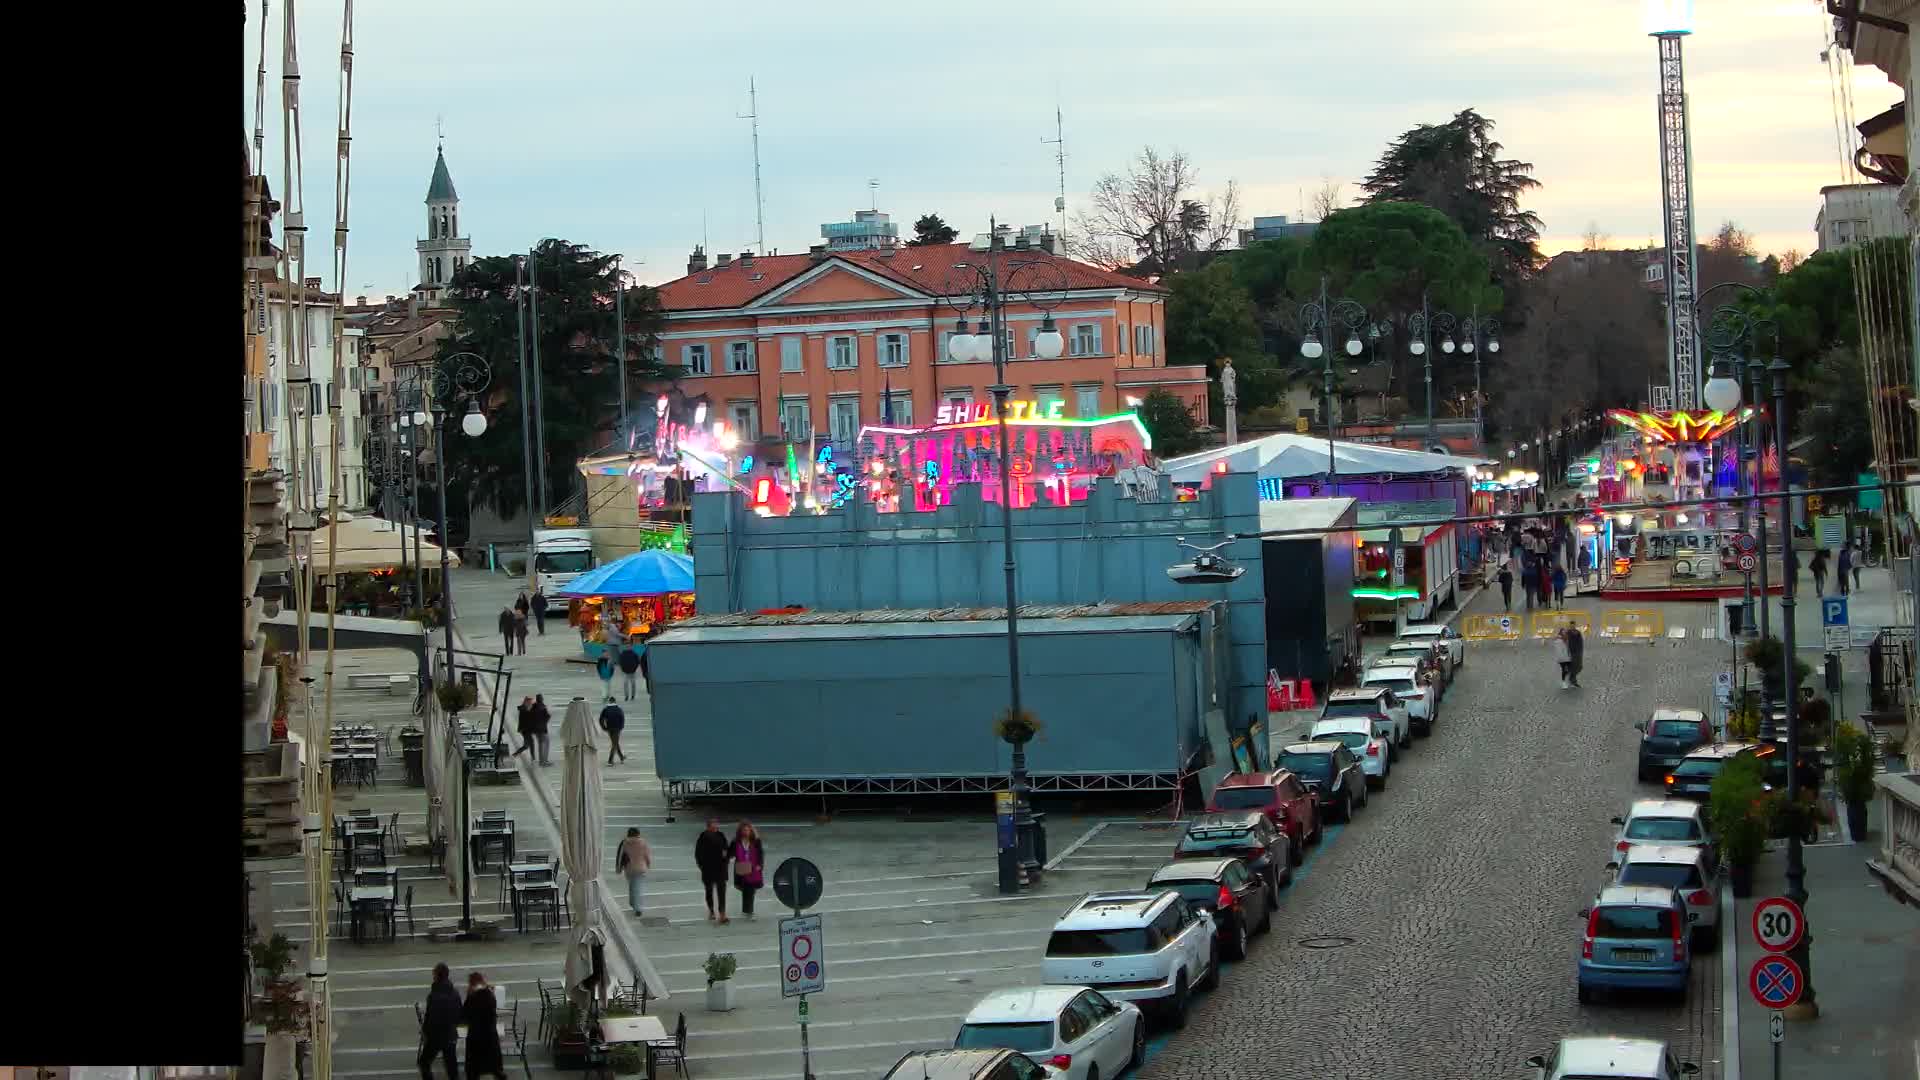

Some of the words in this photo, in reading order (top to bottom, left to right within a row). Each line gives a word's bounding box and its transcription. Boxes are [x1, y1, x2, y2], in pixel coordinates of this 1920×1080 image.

[936, 399, 1066, 425] SHUTLE
[1741, 558, 1753, 568] 20
[1827, 602, 1842, 621] P
[1762, 911, 1792, 938] 30
